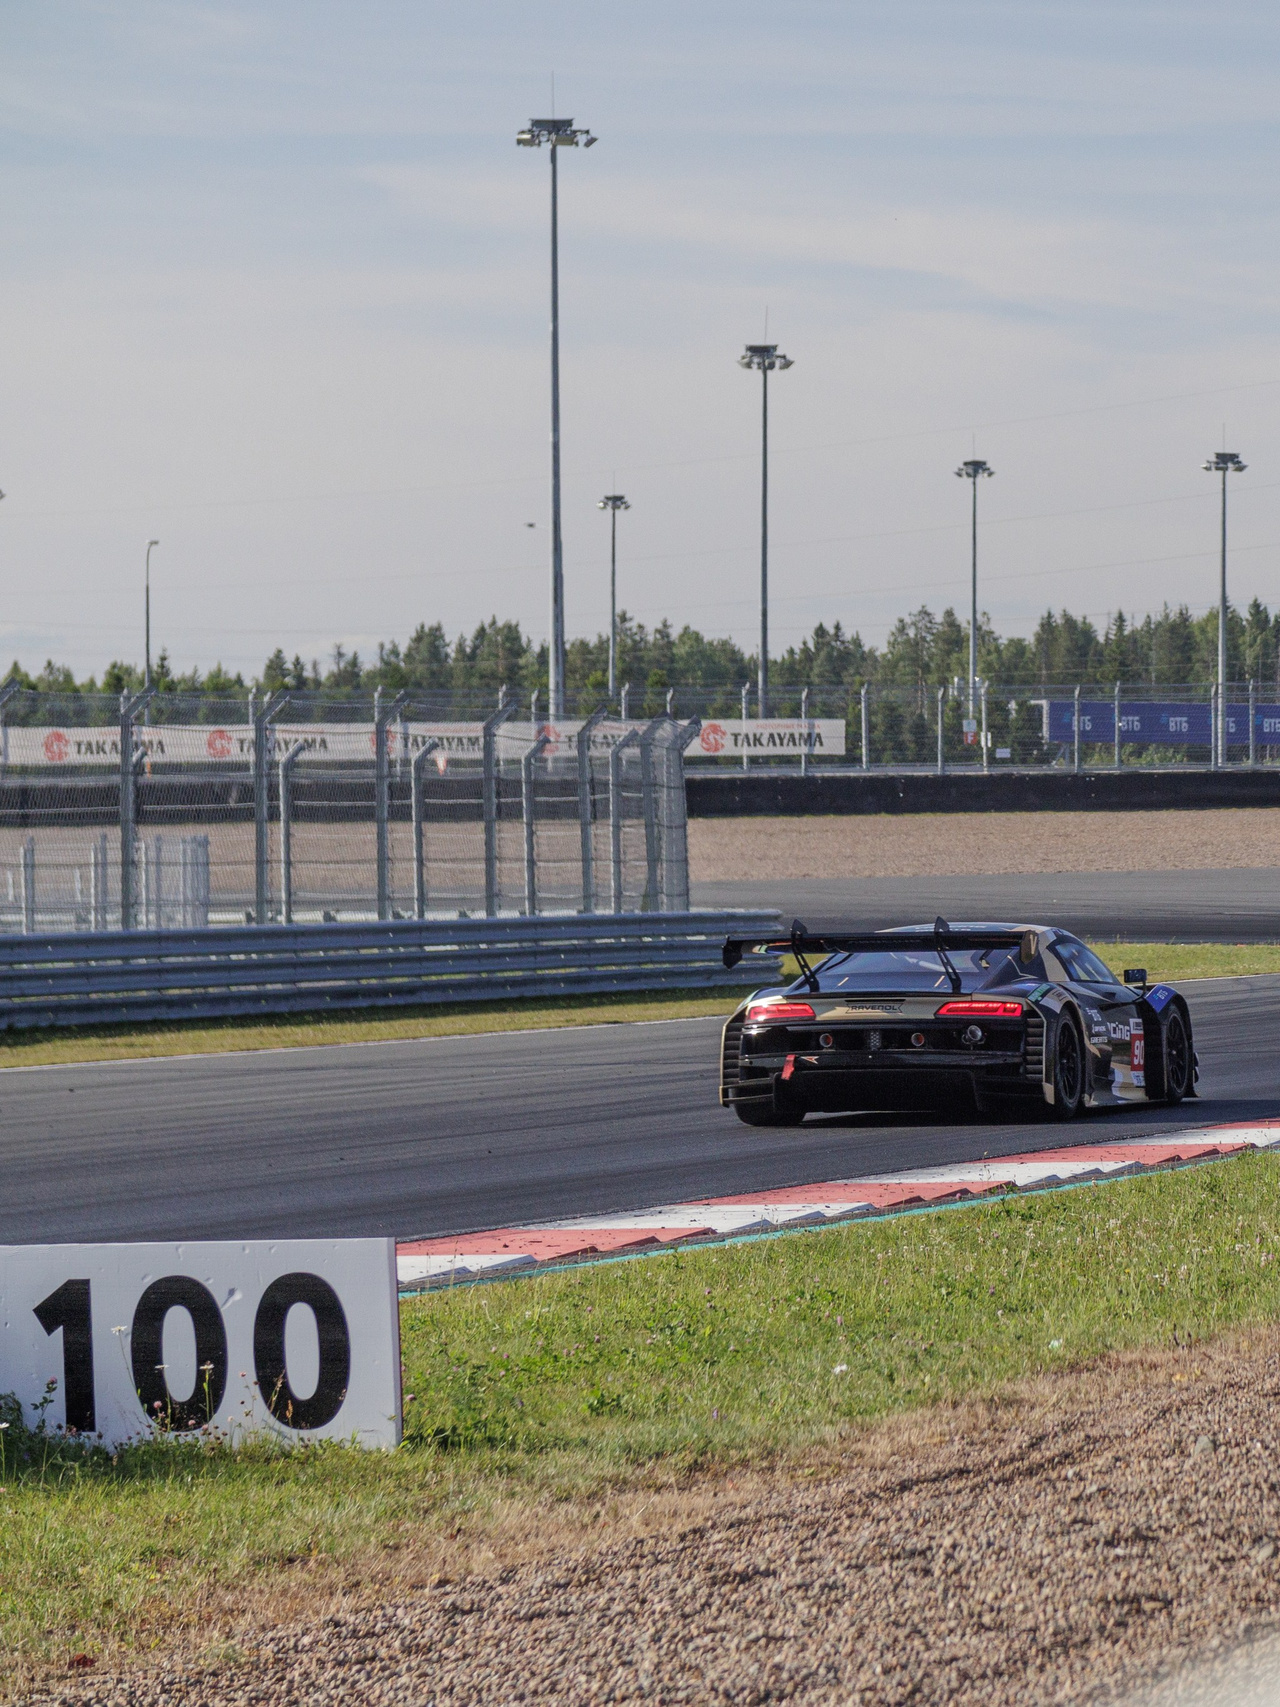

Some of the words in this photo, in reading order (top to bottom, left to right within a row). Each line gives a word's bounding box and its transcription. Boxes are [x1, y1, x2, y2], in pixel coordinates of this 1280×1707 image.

[1121, 716, 1141, 731] ВТБ
[1169, 717, 1188, 732] ВТБ
[730, 732, 823, 747] TAKAYAMA
[32, 1272, 351, 1433] 100
